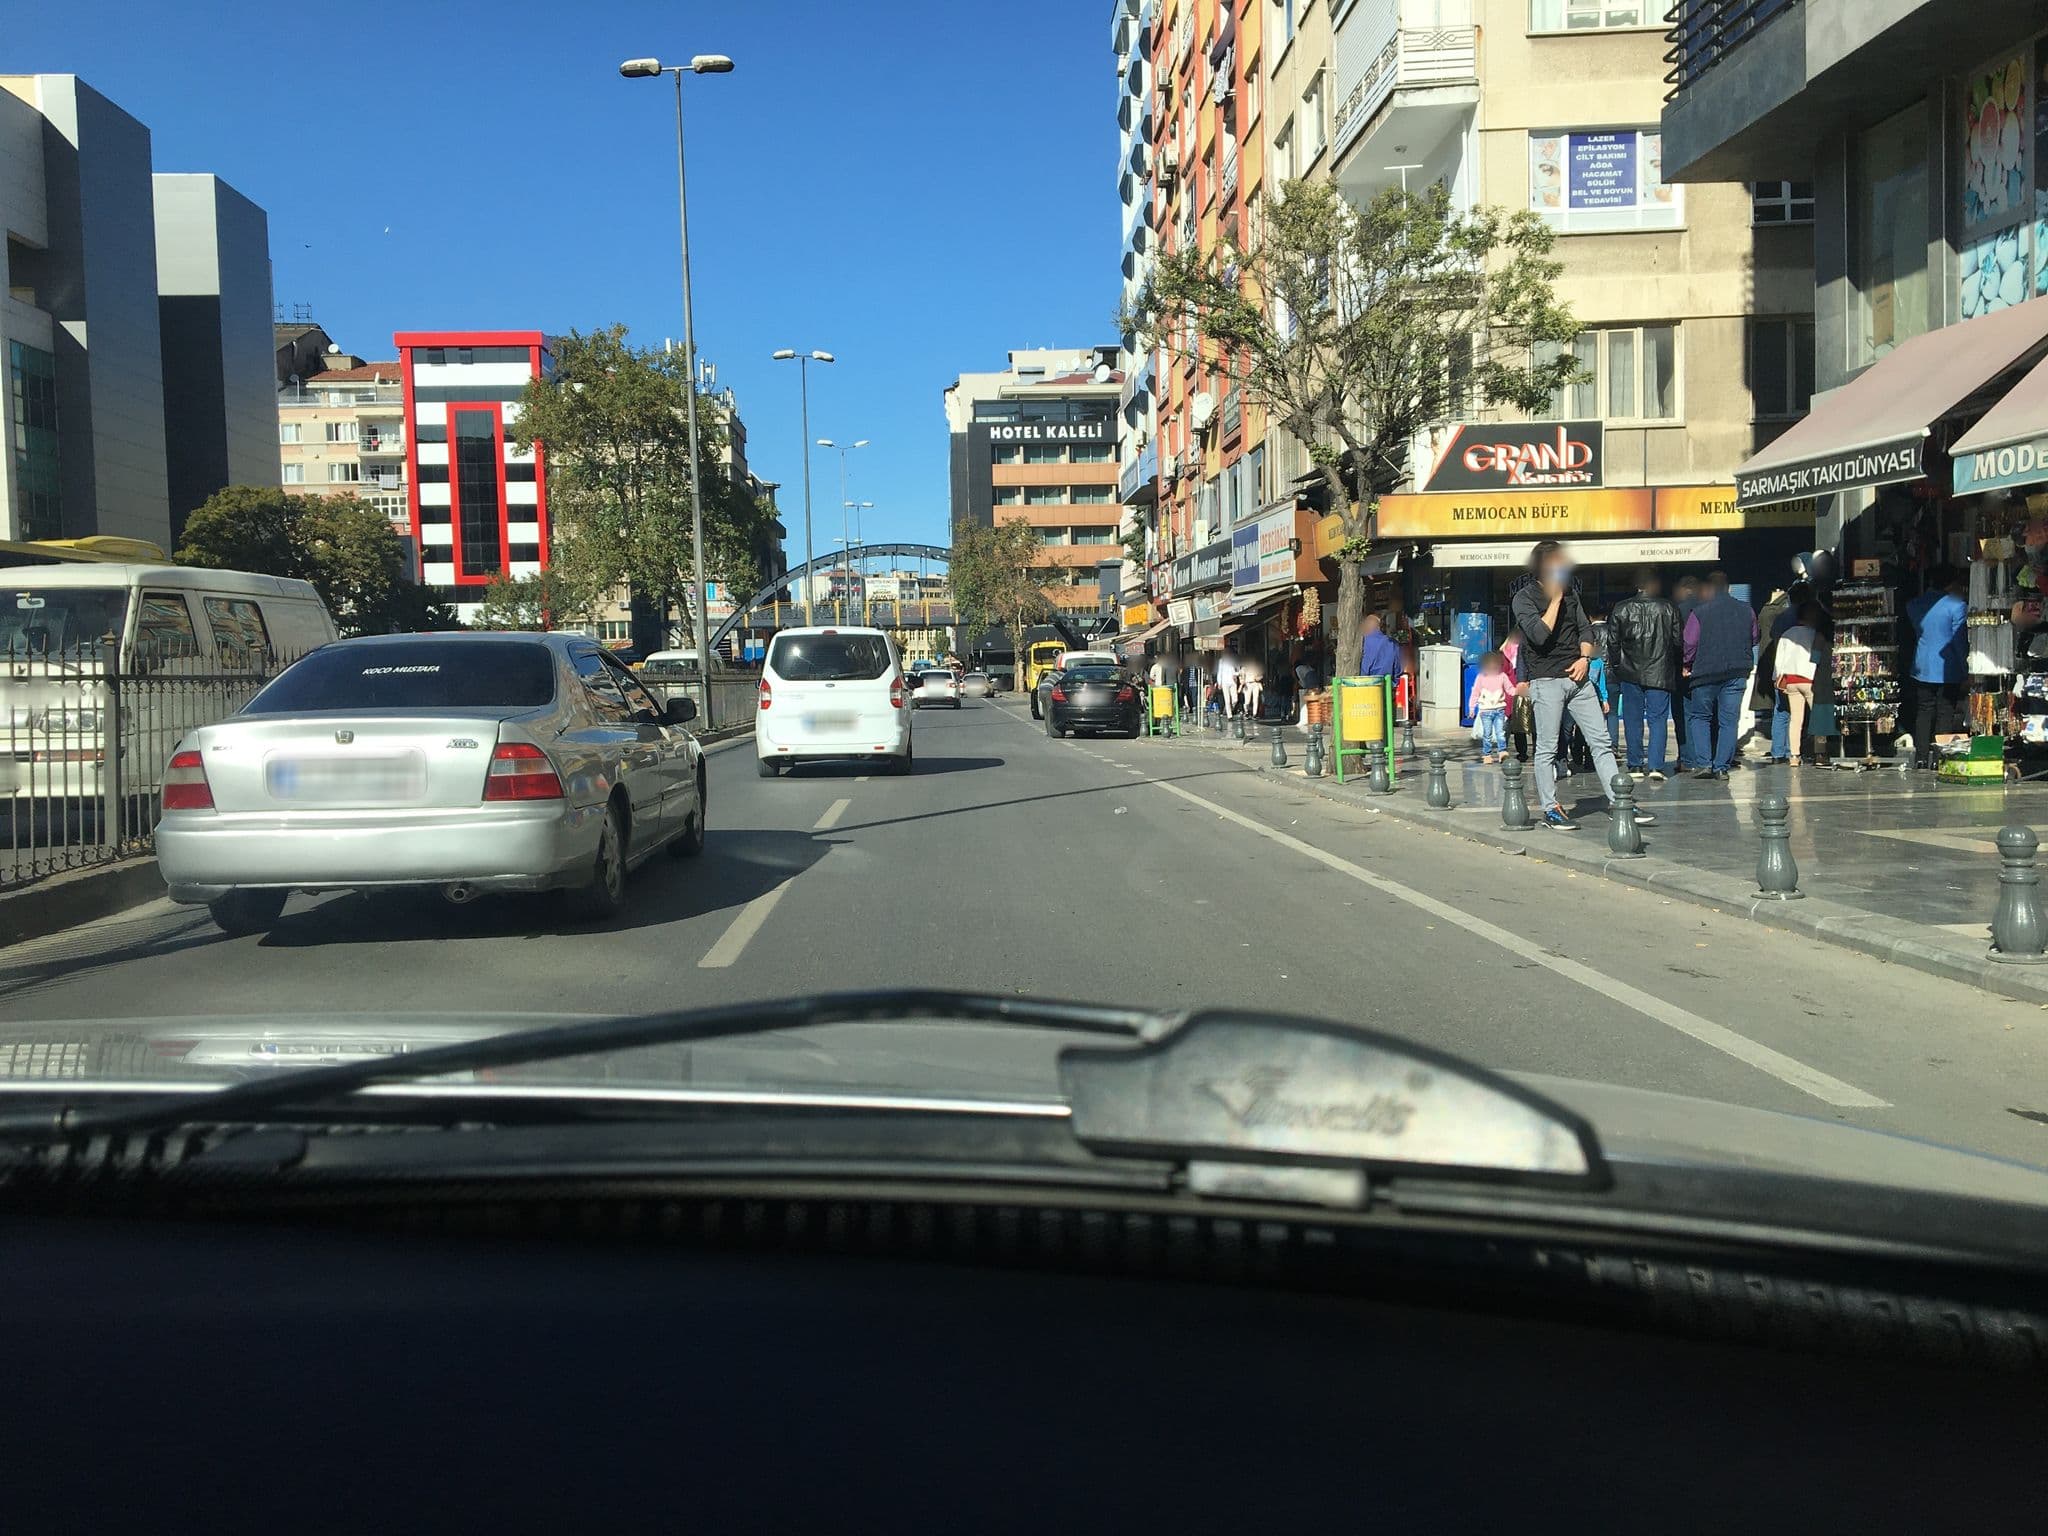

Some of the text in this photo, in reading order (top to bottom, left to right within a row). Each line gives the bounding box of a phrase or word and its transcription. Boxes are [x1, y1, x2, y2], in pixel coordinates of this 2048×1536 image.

[1596, 152, 1627, 160] BAKIMI
[1589, 161, 1613, 169] AĞDA
[1582, 170, 1624, 178] HACAMAT
[1603, 187, 1633, 195] BOYUN
[1583, 196, 1622, 204] TEDAVİSİ
[990, 422, 1102, 439] HOTEL KALELİ
[1463, 425, 1593, 472] GRAND
[1742, 447, 1916, 498] SARMAŞIK TAKI DÜNYASI
[1453, 503, 1569, 520] MEMOCAN BÜFE
[1493, 552, 1511, 560] BÜFE
[1640, 548, 1674, 556] MEMOCAN
[393, 665, 440, 673] MUSTAFA
